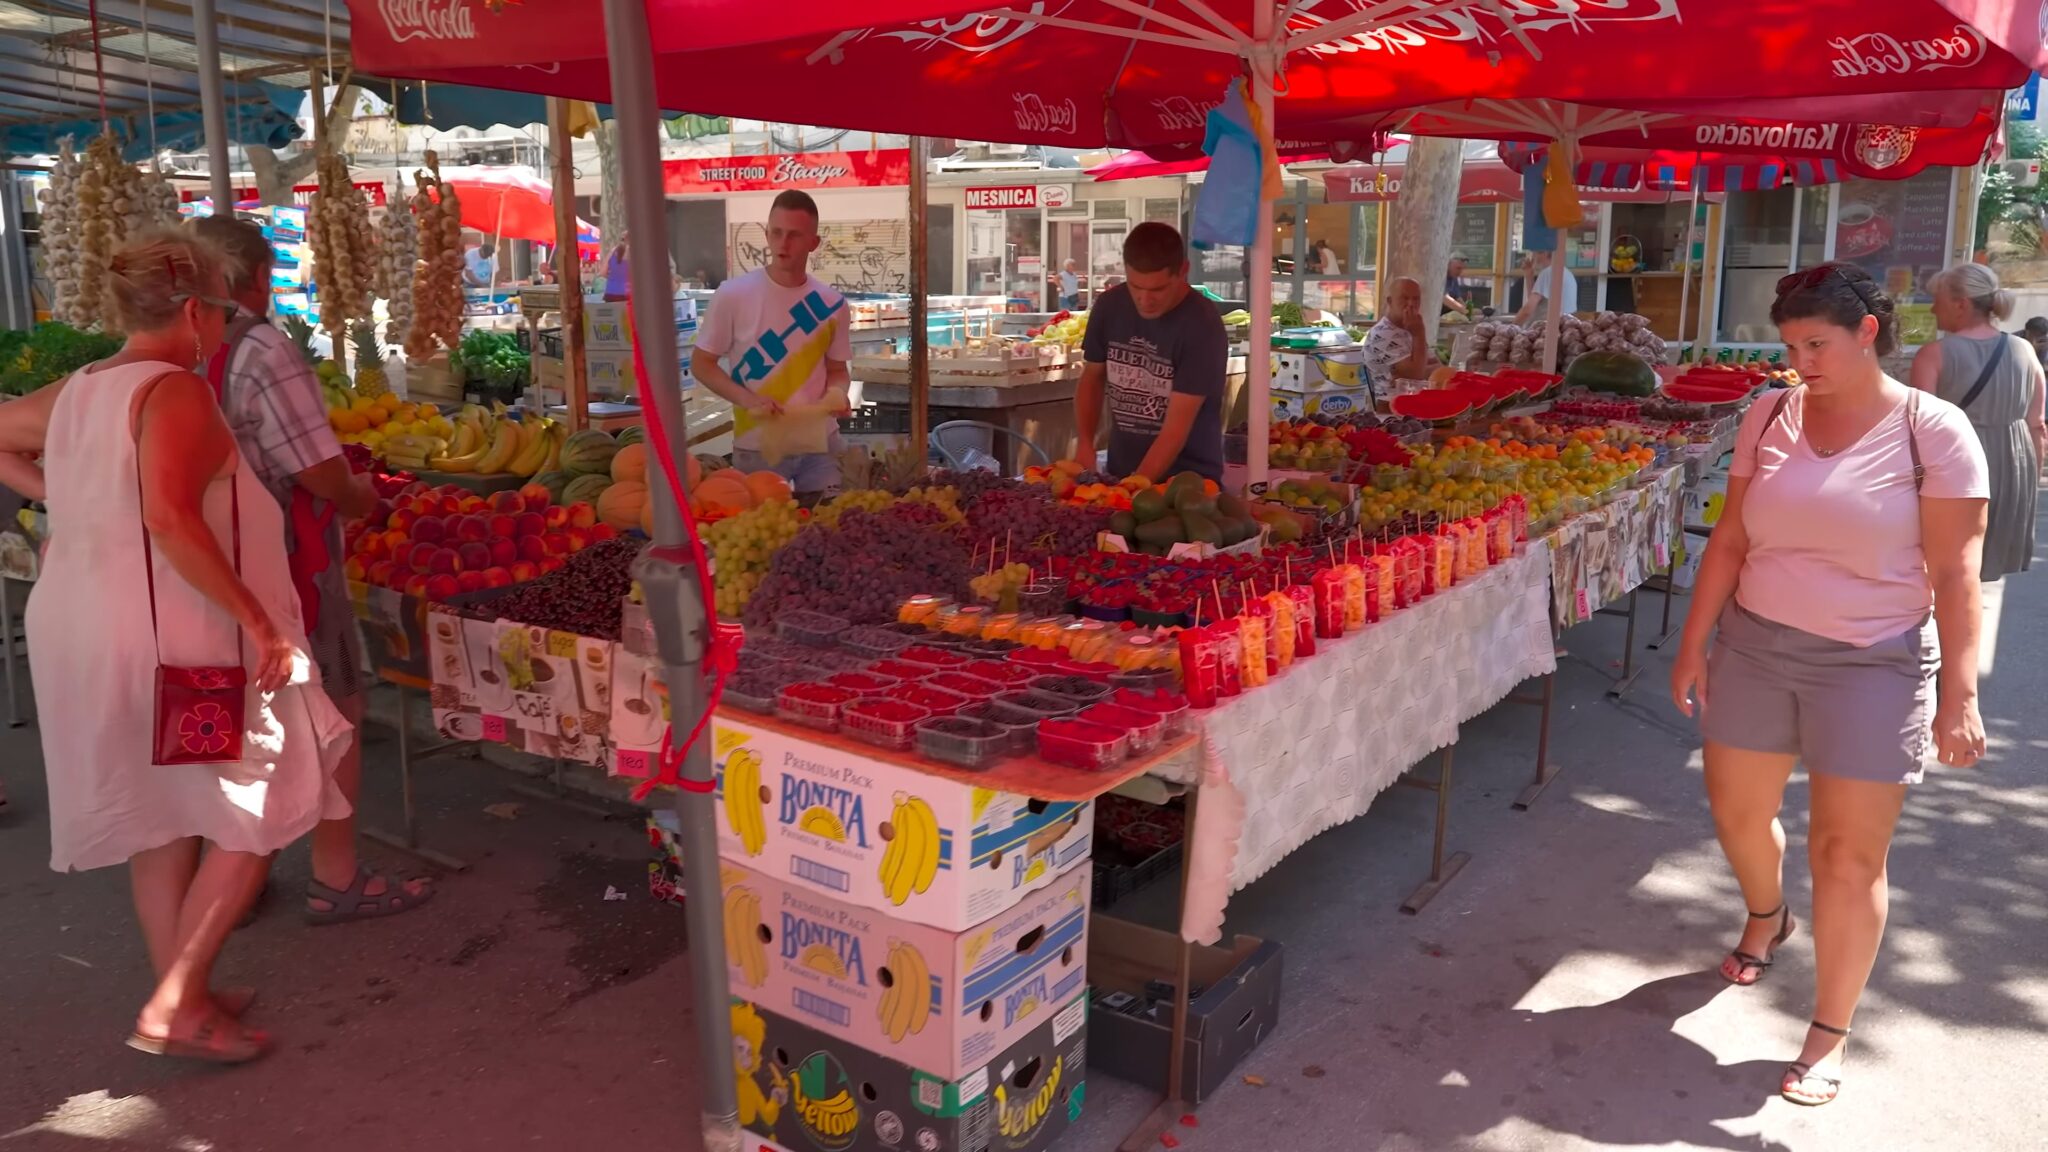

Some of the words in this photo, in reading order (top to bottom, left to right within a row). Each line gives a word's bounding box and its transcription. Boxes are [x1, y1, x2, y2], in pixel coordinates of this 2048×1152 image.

[700, 168, 737, 181] STREET
[739, 166, 767, 180] FOOD
[966, 188, 1035, 206] MESNICA
[1322, 397, 1351, 411] derby
[778, 772, 869, 848] BONITA
[780, 911, 869, 987] BONITA
[1004, 972, 1048, 1030] BONITA
